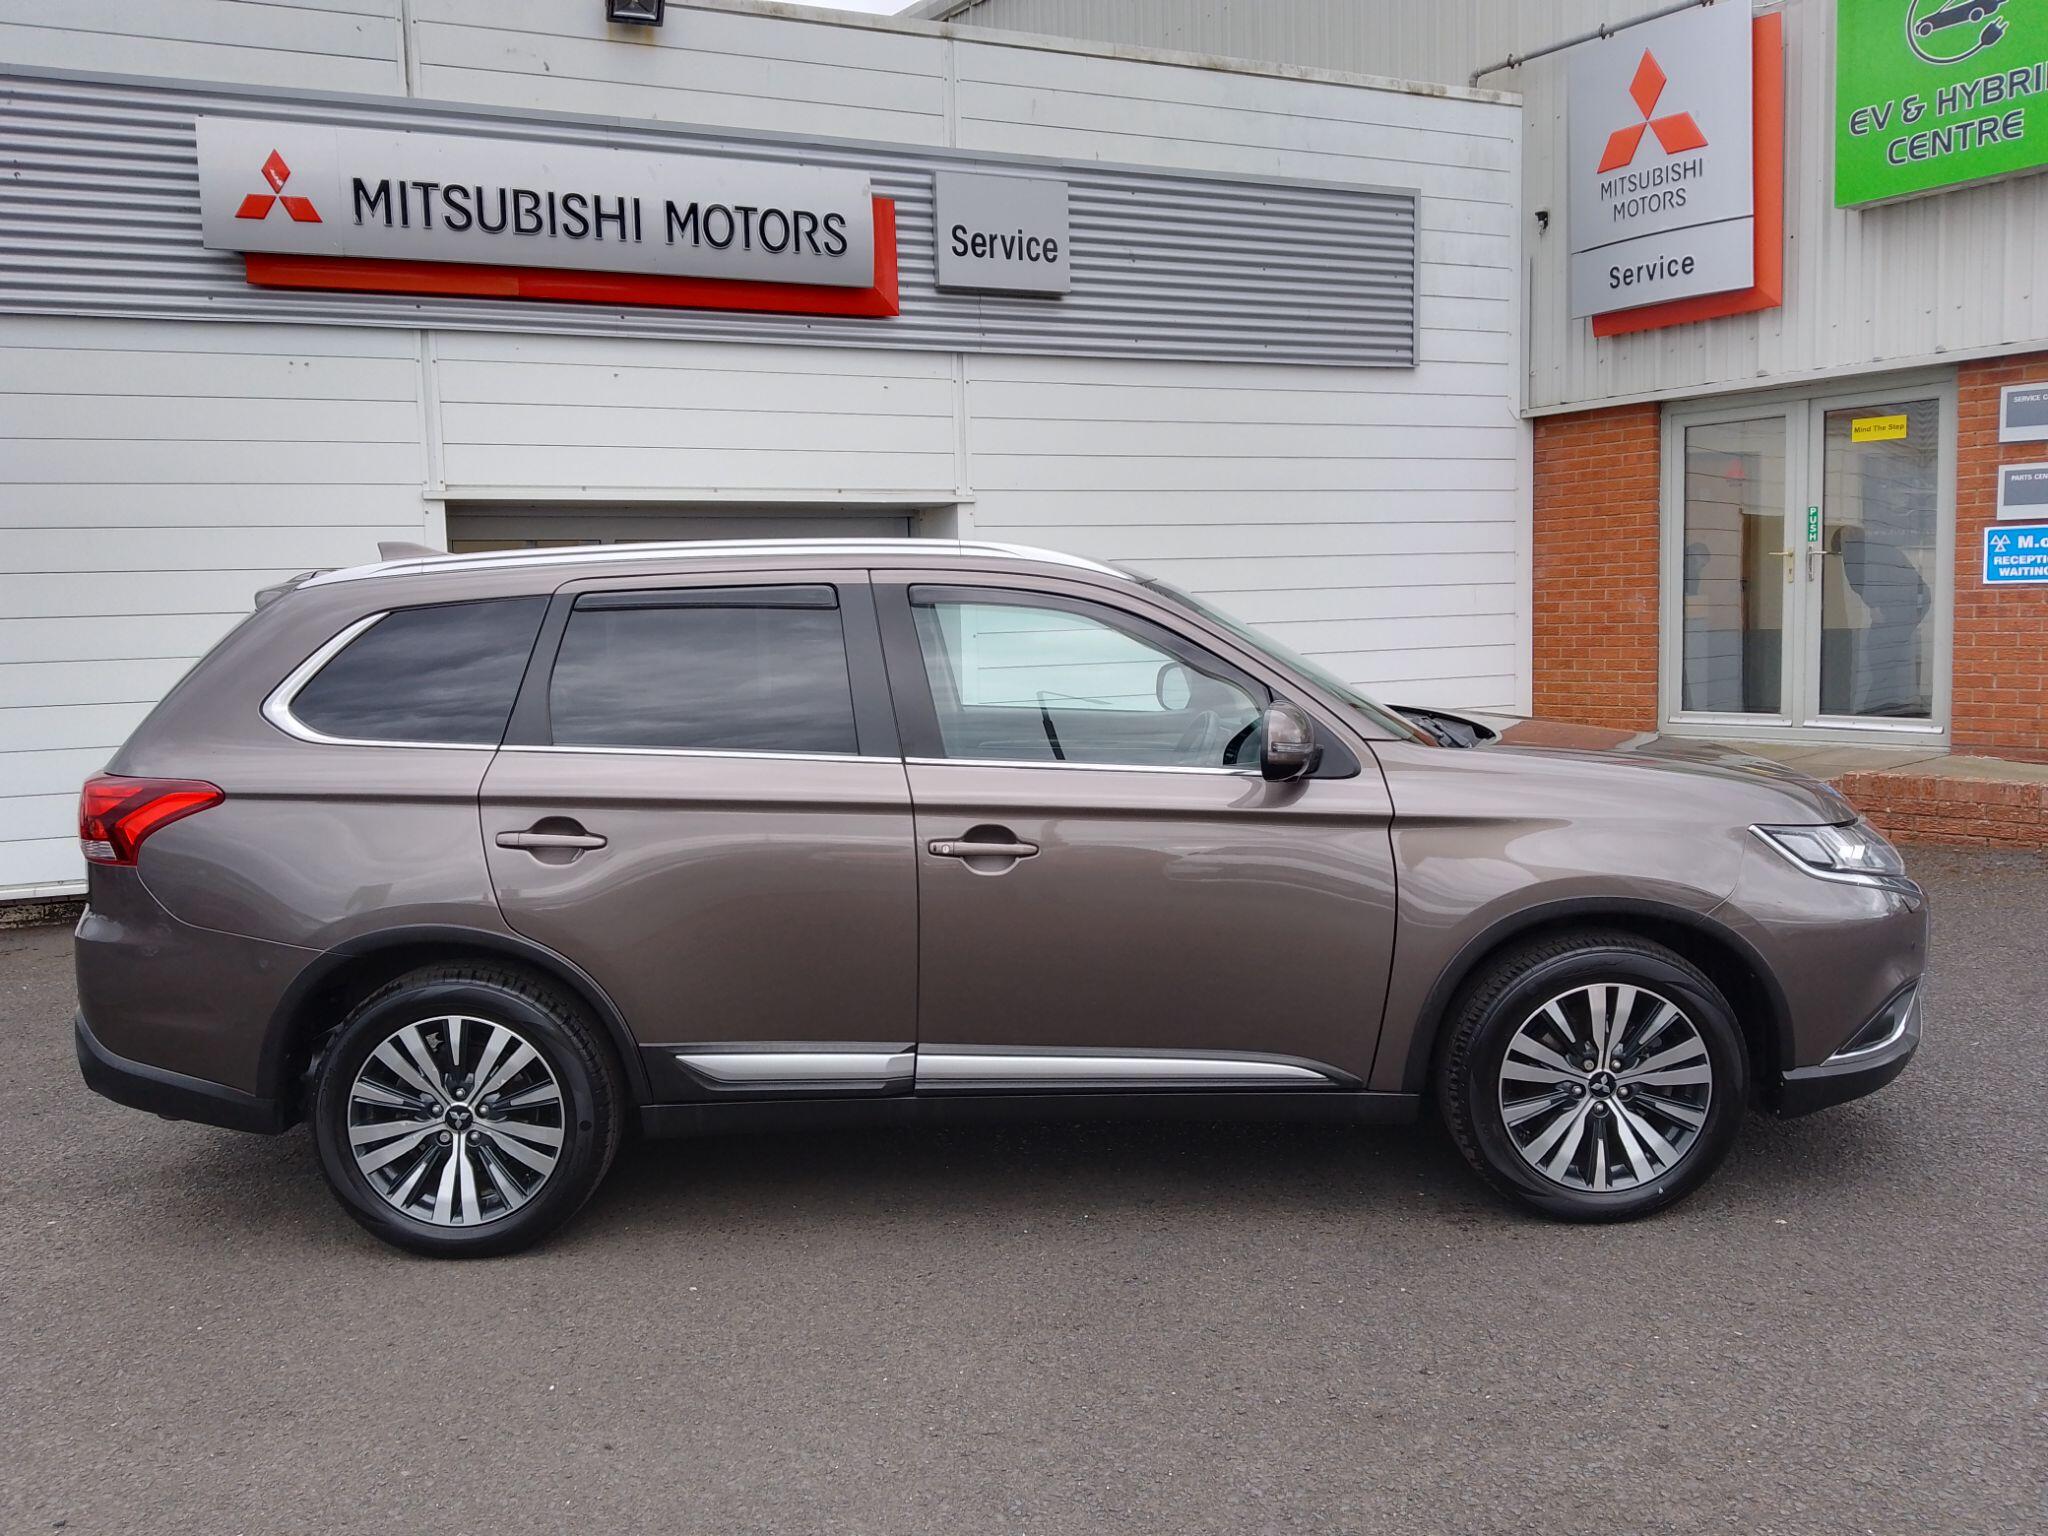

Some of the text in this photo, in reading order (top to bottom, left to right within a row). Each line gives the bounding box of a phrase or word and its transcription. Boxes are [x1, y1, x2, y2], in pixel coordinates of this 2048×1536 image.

[1849, 62, 2048, 136] EV & HYBRI
[1887, 108, 2025, 166] CENTRE
[1601, 158, 1703, 201] MITSUBISHI
[352, 177, 848, 257] MITSUBISHI MOTORS
[1613, 187, 1687, 222] MOTORS
[951, 223, 1059, 264] Service
[1609, 255, 1695, 289] Service
[1854, 423, 1905, 433] Mind The Step
